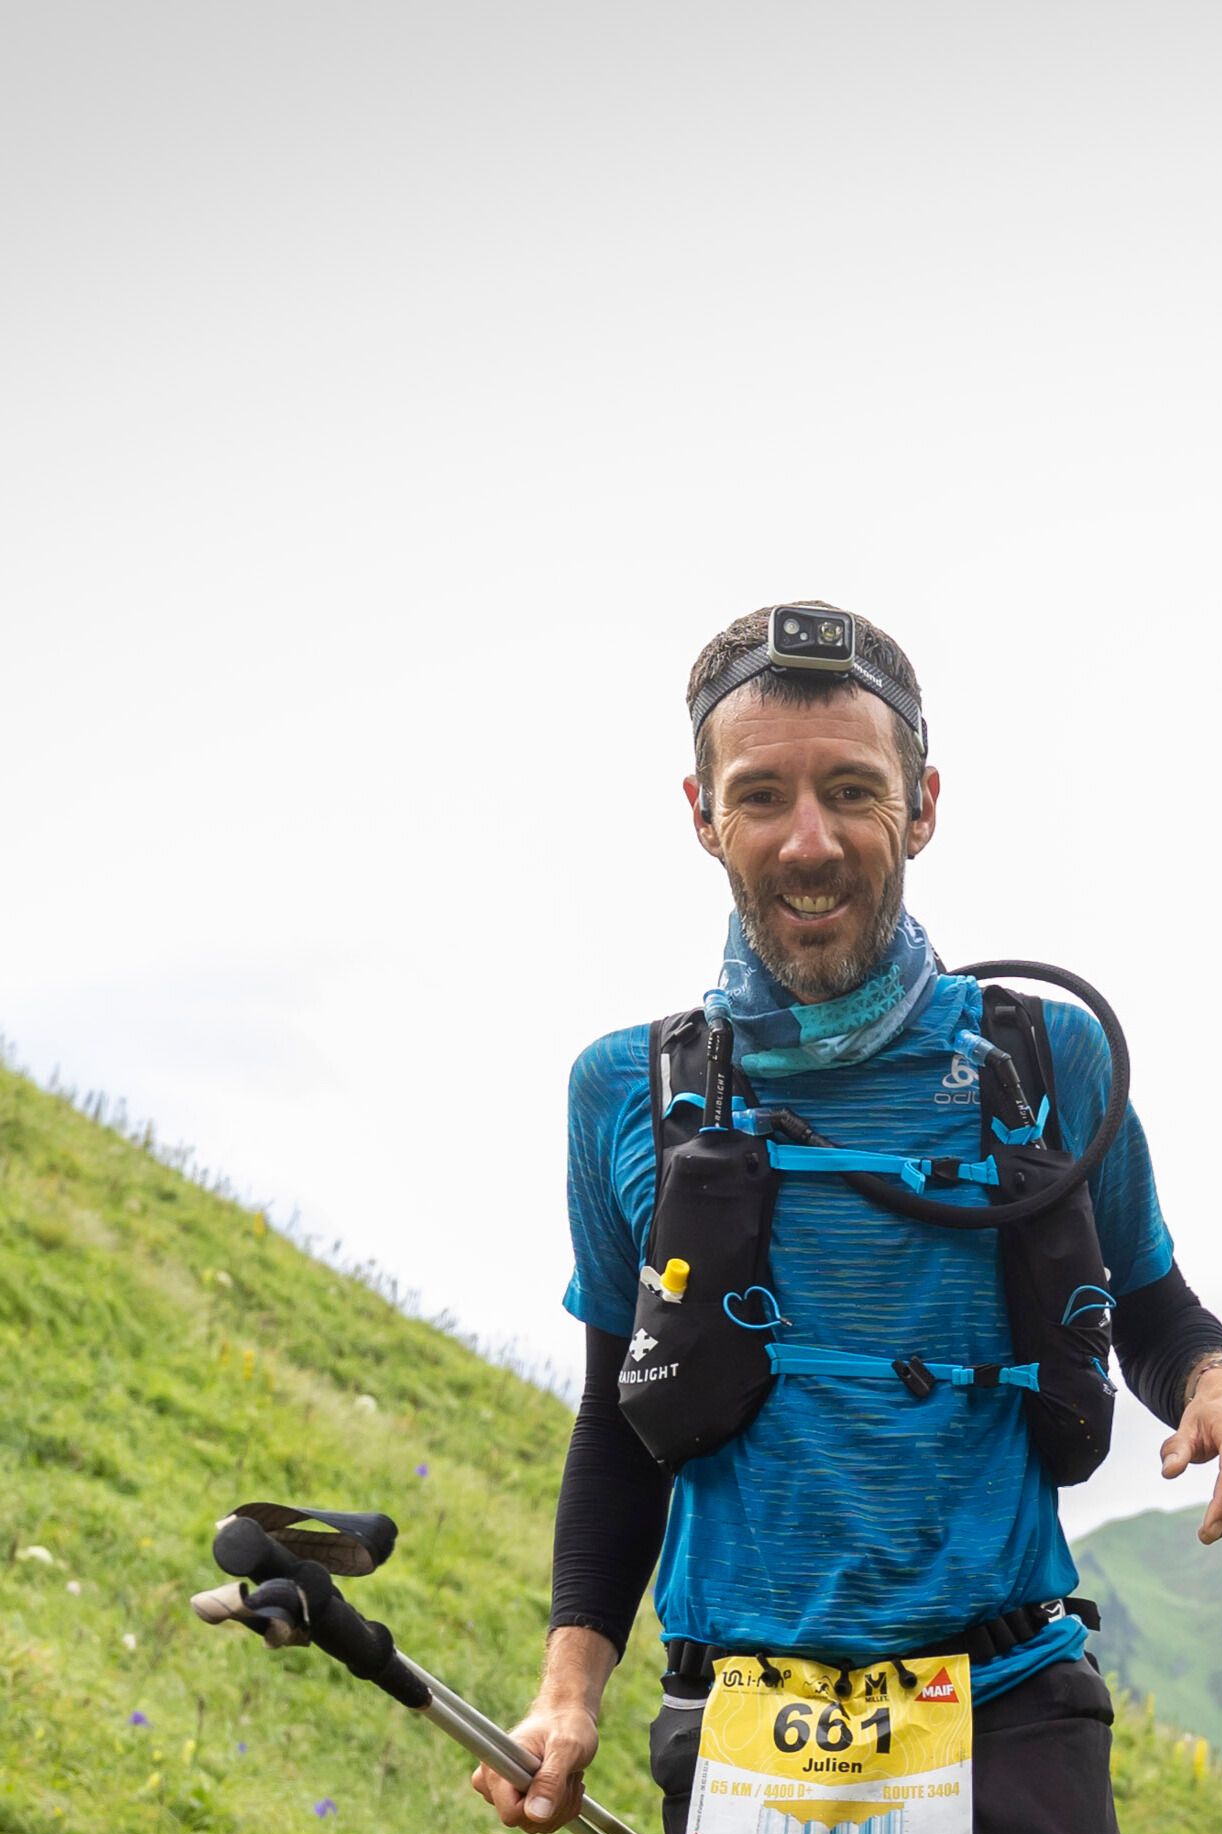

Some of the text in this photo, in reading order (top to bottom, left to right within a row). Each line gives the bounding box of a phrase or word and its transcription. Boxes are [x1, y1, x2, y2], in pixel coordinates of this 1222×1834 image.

[853, 662, 882, 688] mond
[714, 1073, 725, 1119] RAIDLIGHT
[934, 1091, 980, 1104] odl
[747, 1670, 785, 1689] i-rn
[922, 1684, 953, 1698] MAIF
[774, 1703, 891, 1754] 661
[802, 1758, 862, 1774] Julien
[711, 1780, 728, 1794] 65
[732, 1782, 752, 1796] KM
[764, 1783, 795, 1798] 4400
[883, 1782, 960, 1799] ROUTE 3404
